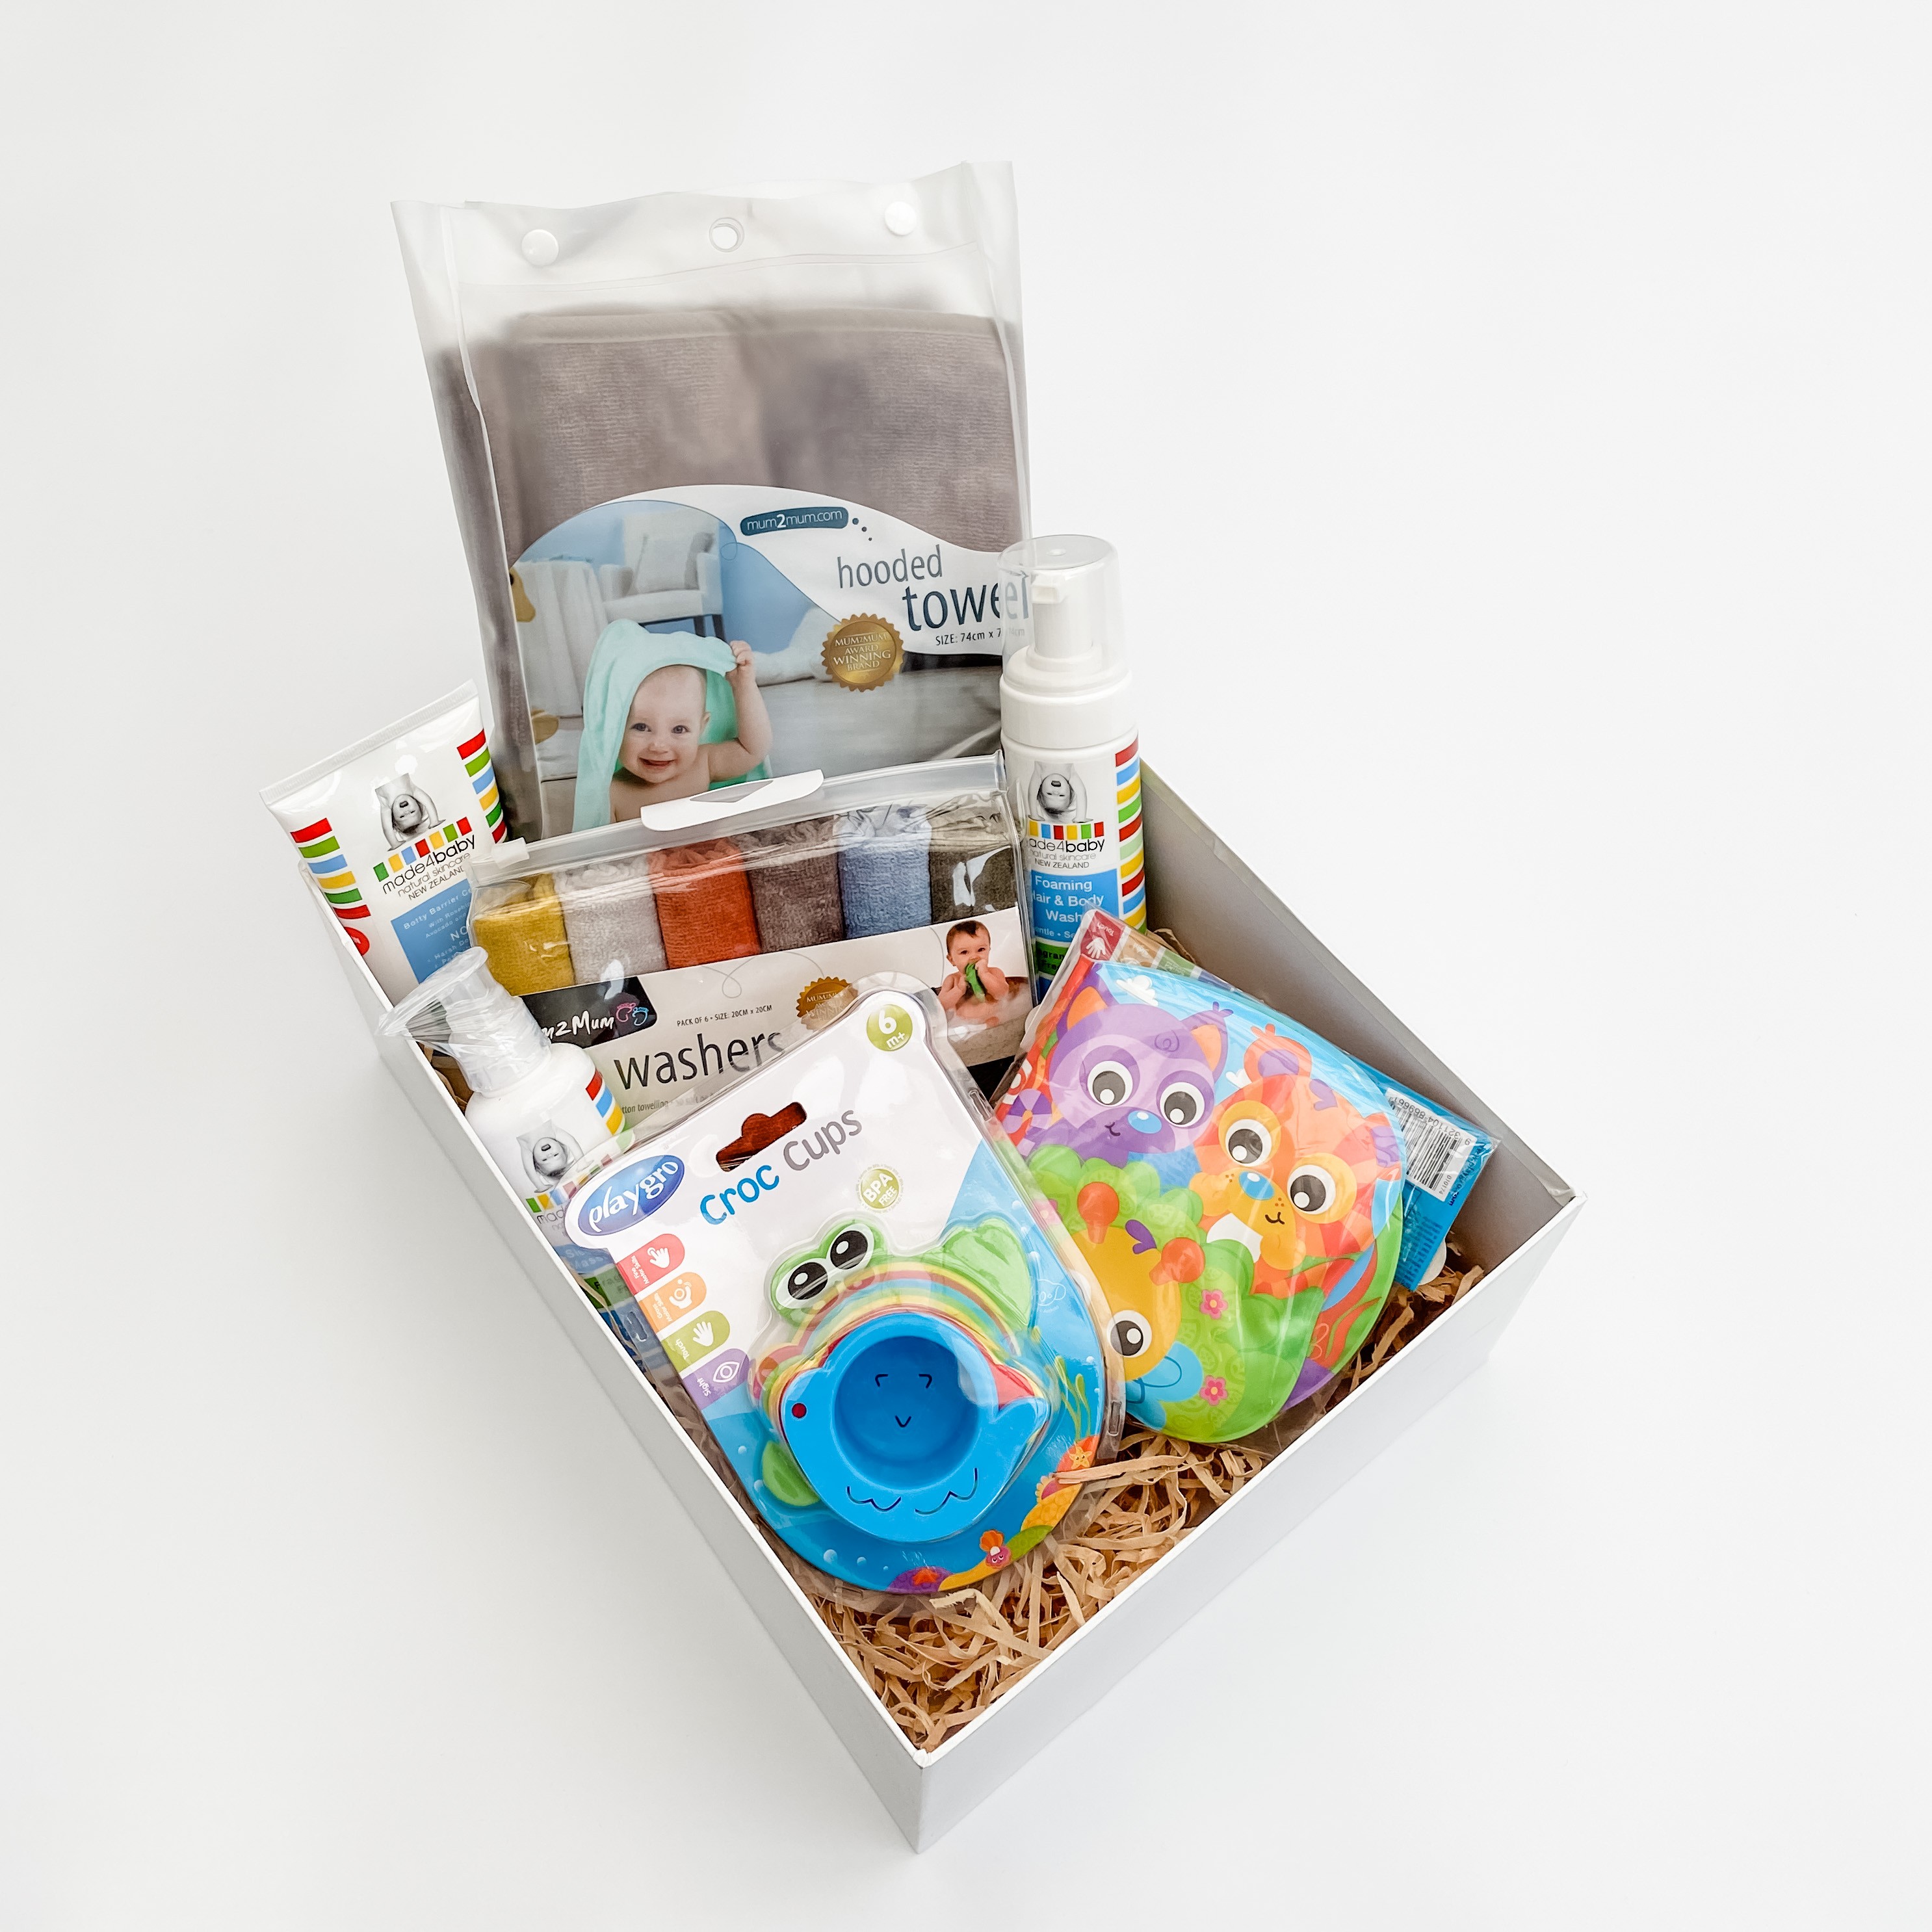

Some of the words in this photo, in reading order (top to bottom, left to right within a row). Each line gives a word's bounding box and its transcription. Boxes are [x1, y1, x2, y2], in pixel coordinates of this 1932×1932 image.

[748, 510, 842, 530] mum2mum.com
[837, 544, 943, 588] hooded
[835, 632, 888, 646] MUM2MUM
[935, 633, 958, 646] SIZE:
[961, 632, 985, 642] 74cm
[833, 650, 891, 665] WINNING
[845, 644, 878, 655] AWARD
[847, 660, 880, 672] BRAND
[1028, 838, 1104, 853] ade4baby
[382, 835, 475, 894] made4baby
[1035, 859, 1051, 867] NEW
[1060, 853, 1097, 861] skincare
[398, 872, 430, 897] natural
[433, 852, 470, 876] skincare
[1035, 875, 1093, 892] Foaming
[408, 885, 426, 900] NEW
[1054, 895, 1064, 906] &
[1068, 894, 1104, 907] Body
[403, 913, 427, 930] Botty
[429, 895, 459, 915] Barrier
[425, 920, 454, 938] Avocado
[1096, 921, 1114, 937] Touch
[677, 1018, 694, 1027] PACK
[732, 1009, 748, 1018] 20CM
[755, 1004, 772, 1013] 20CM
[879, 1009, 897, 1034] 6
[886, 1032, 905, 1049] m+
[614, 1032, 785, 1090] washers
[1429, 1116, 1461, 1140] 321104
[863, 1173, 893, 1203] BPA
[1439, 1175, 1452, 1195] 010174
[589, 1161, 679, 1233] playgro
[878, 1186, 897, 1206] FREE
[631, 1255, 641, 1270] Skills
[631, 1267, 640, 1279] Fine
[638, 1268, 650, 1285] Motor
[675, 1338, 690, 1361] Touch
[697, 1377, 711, 1397] Sight
